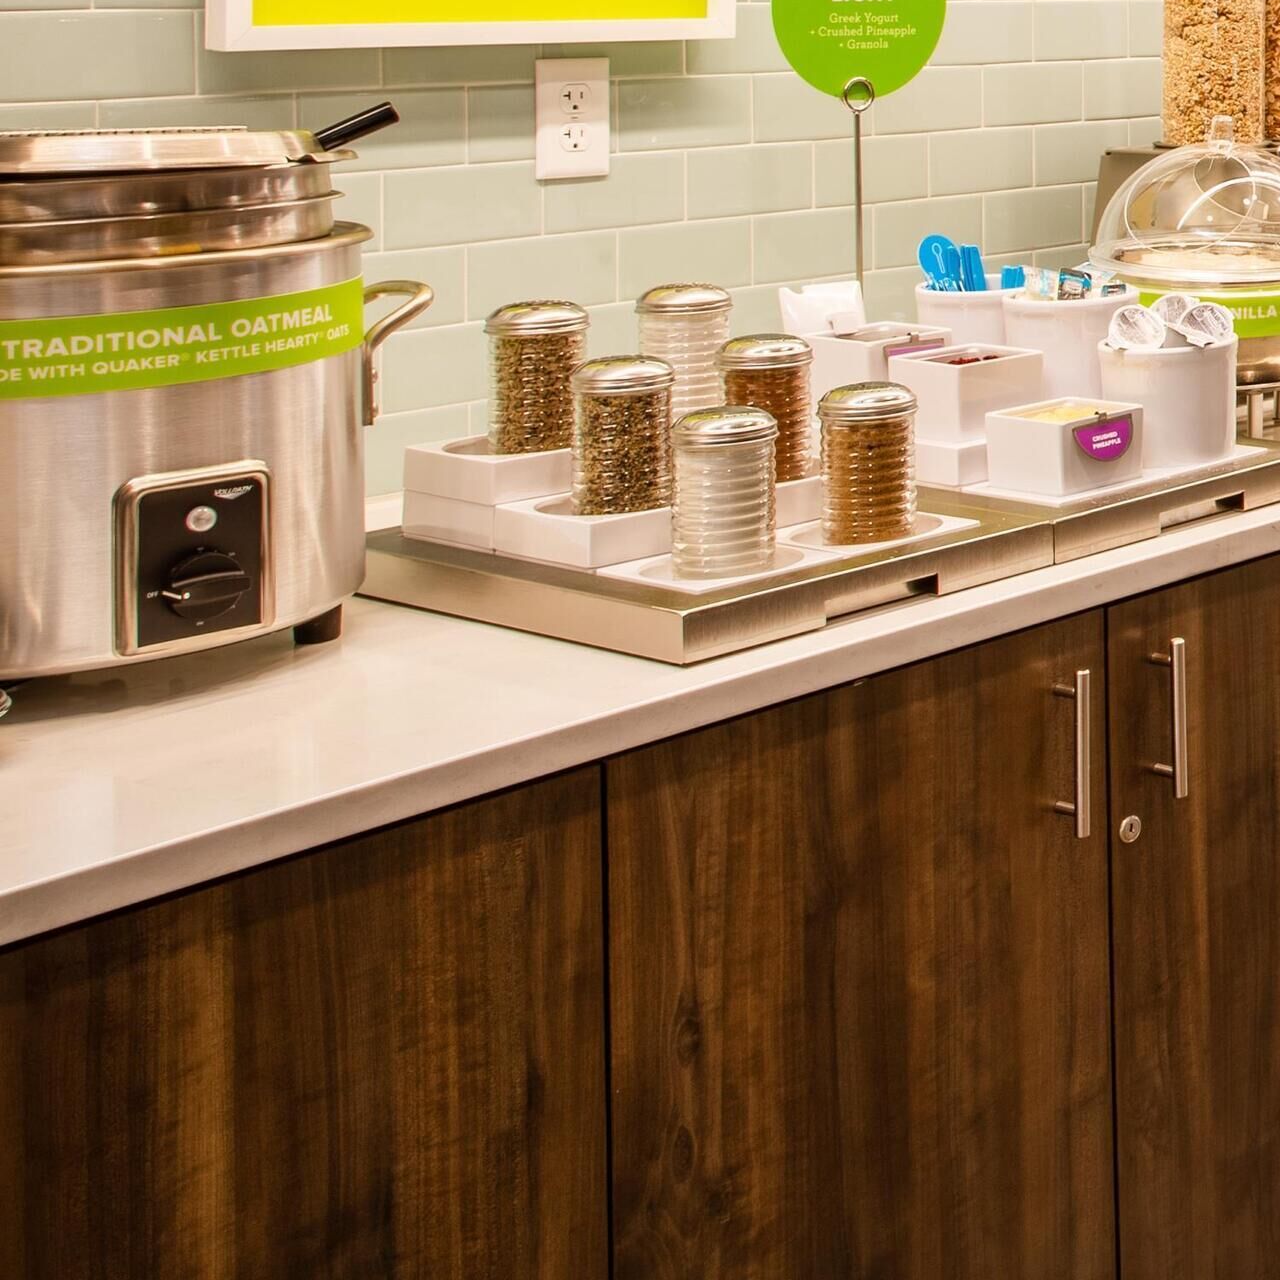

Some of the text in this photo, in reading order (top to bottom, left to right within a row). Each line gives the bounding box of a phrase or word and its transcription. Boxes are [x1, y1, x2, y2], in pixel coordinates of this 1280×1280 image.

[829, 12, 899, 26] Greek Yogurt
[818, 24, 917, 38] Crushed Pineapple
[847, 38, 889, 50] Granola
[1, 304, 333, 360] TRADITIONAL OATMEAL
[29, 364, 85, 380] WITH
[196, 343, 261, 363] KETTLE
[327, 324, 350, 341] OATS
[1092, 431, 1118, 442] CRUSHED
[1092, 437, 1121, 450] PINEAPPLE
[146, 590, 159, 598] OFF
